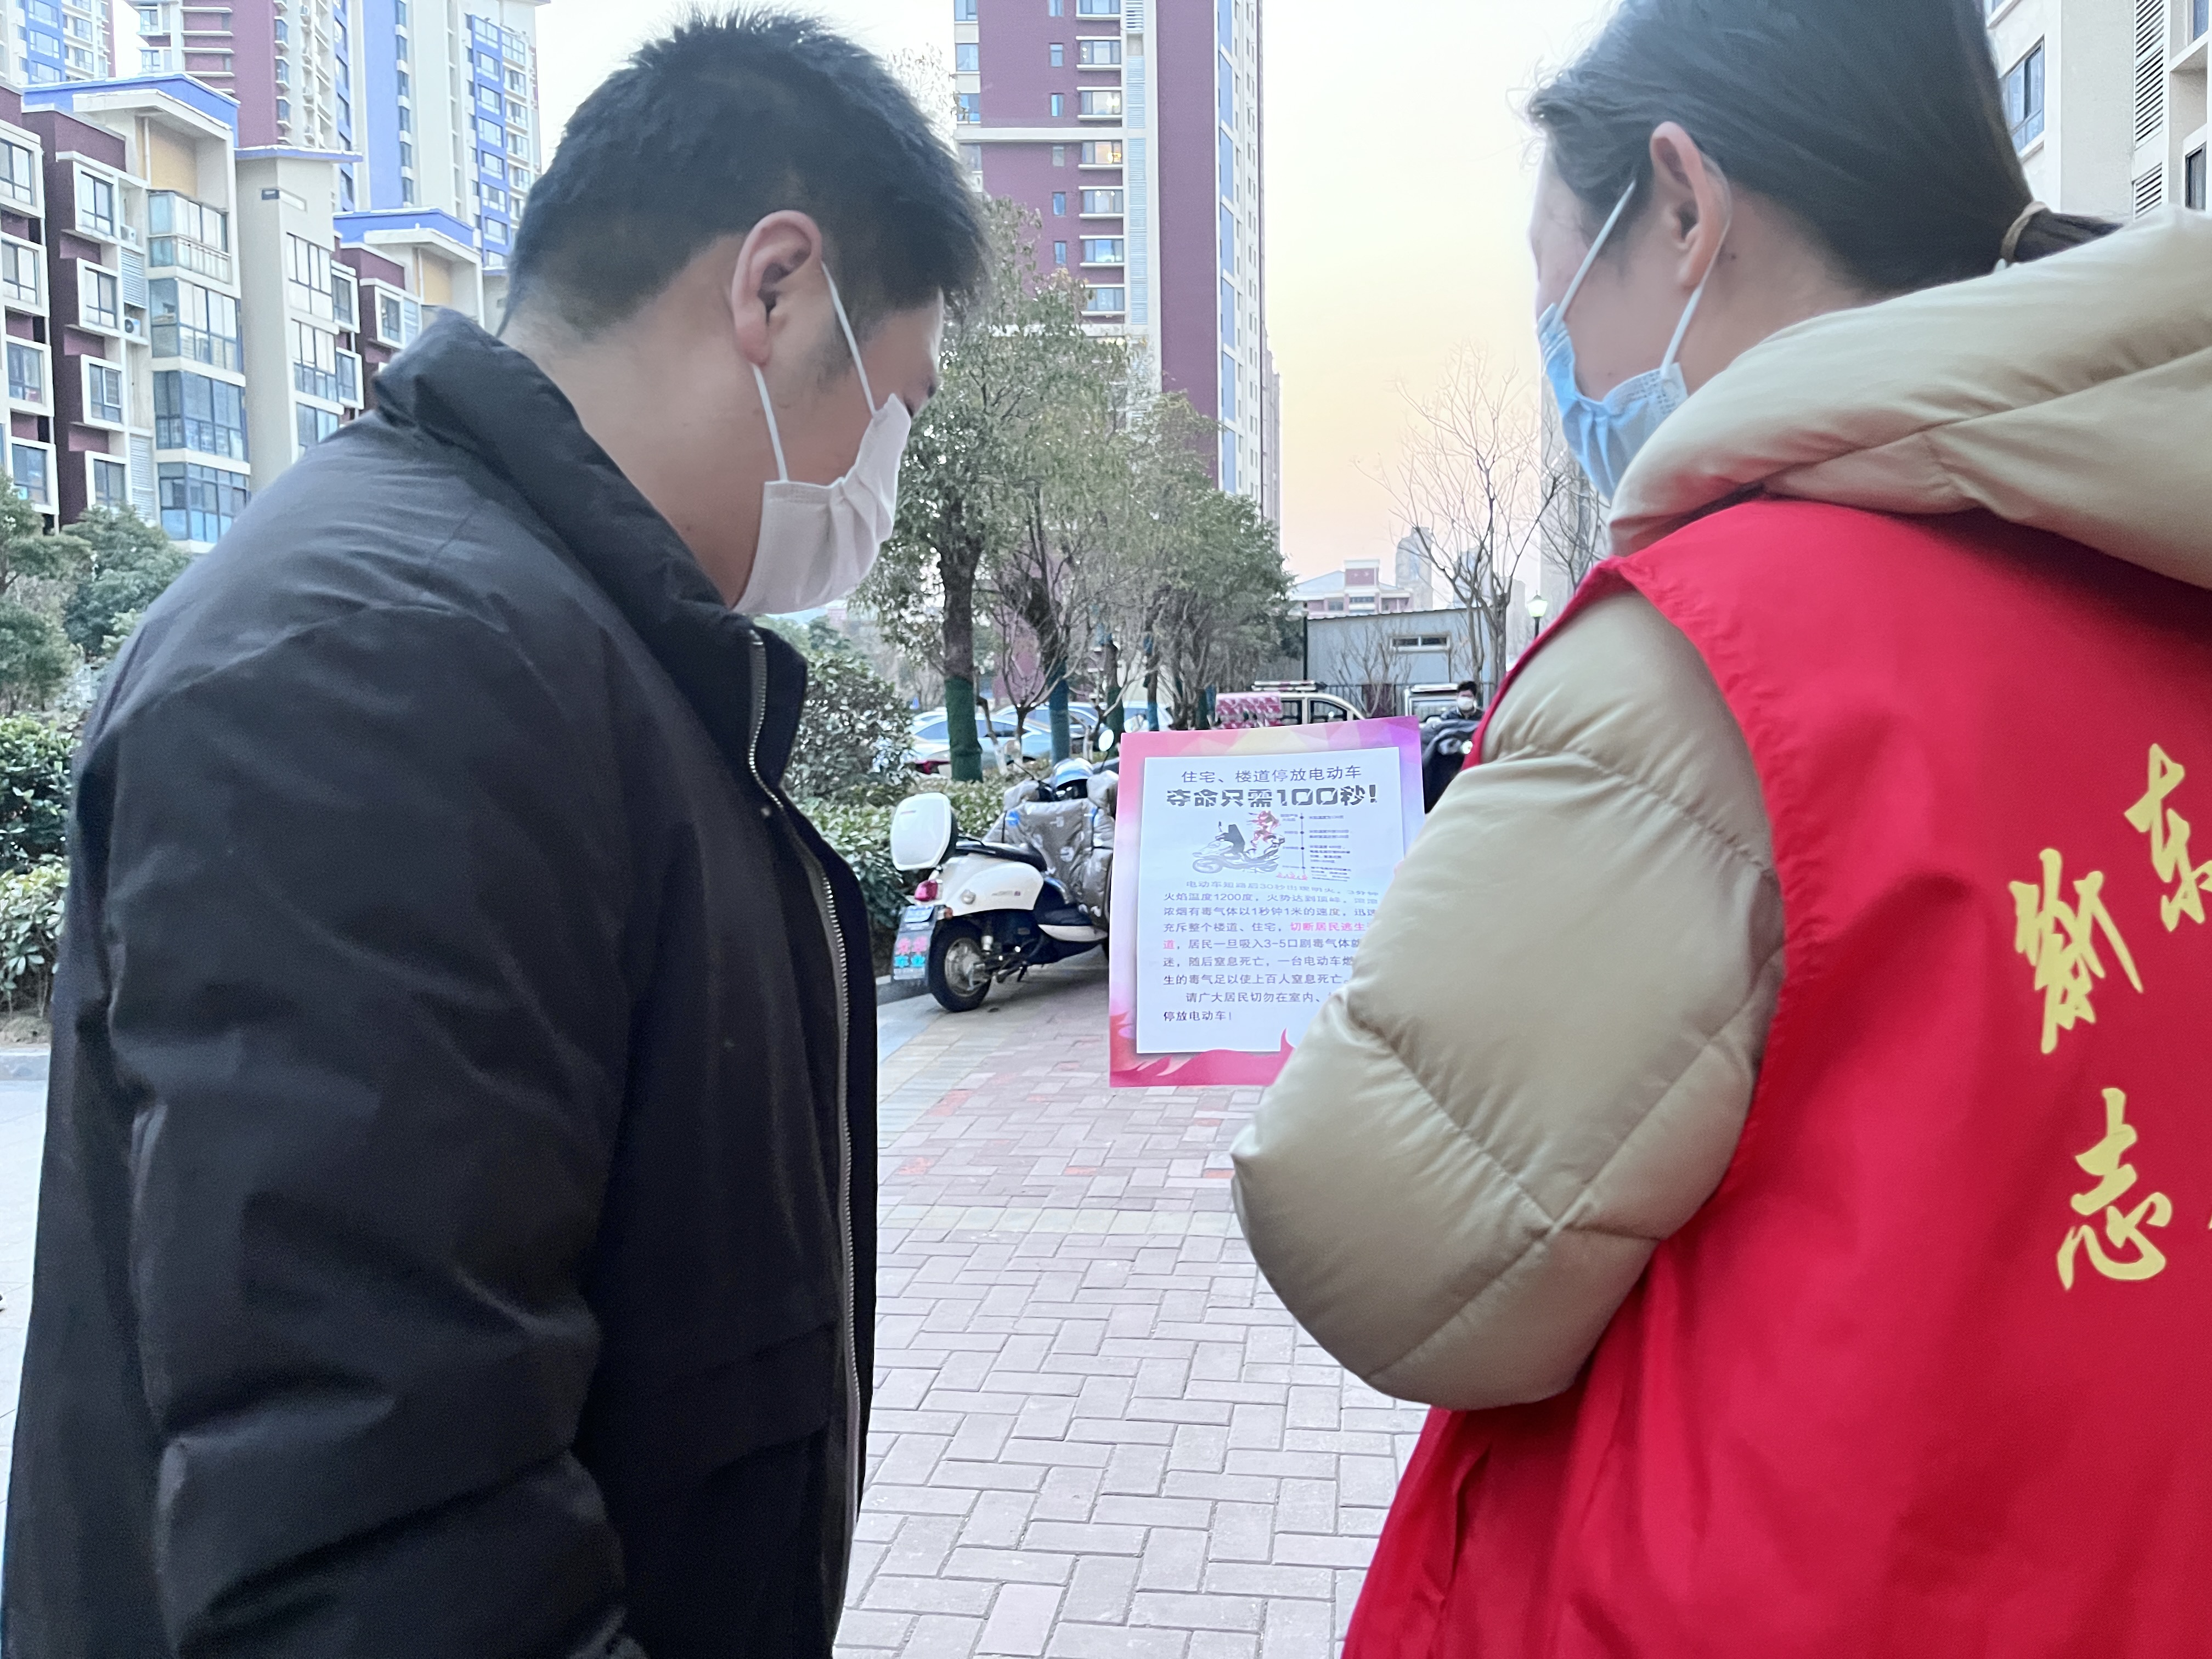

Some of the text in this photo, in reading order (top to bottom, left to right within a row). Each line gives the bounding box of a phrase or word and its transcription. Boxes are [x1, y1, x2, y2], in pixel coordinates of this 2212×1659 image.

[1181, 765, 1362, 783] 住宅、楼道停放电动车
[1166, 785, 1378, 808] 夺命只需100秒!
[1164, 922, 1370, 932] 充斥整个楼道、住宅,切断居民逃生
[1163, 974, 1348, 985] 生的毒气足以使上百人窒息死亡。
[1186, 992, 1331, 1003] 请广大居民切勿在室内、
